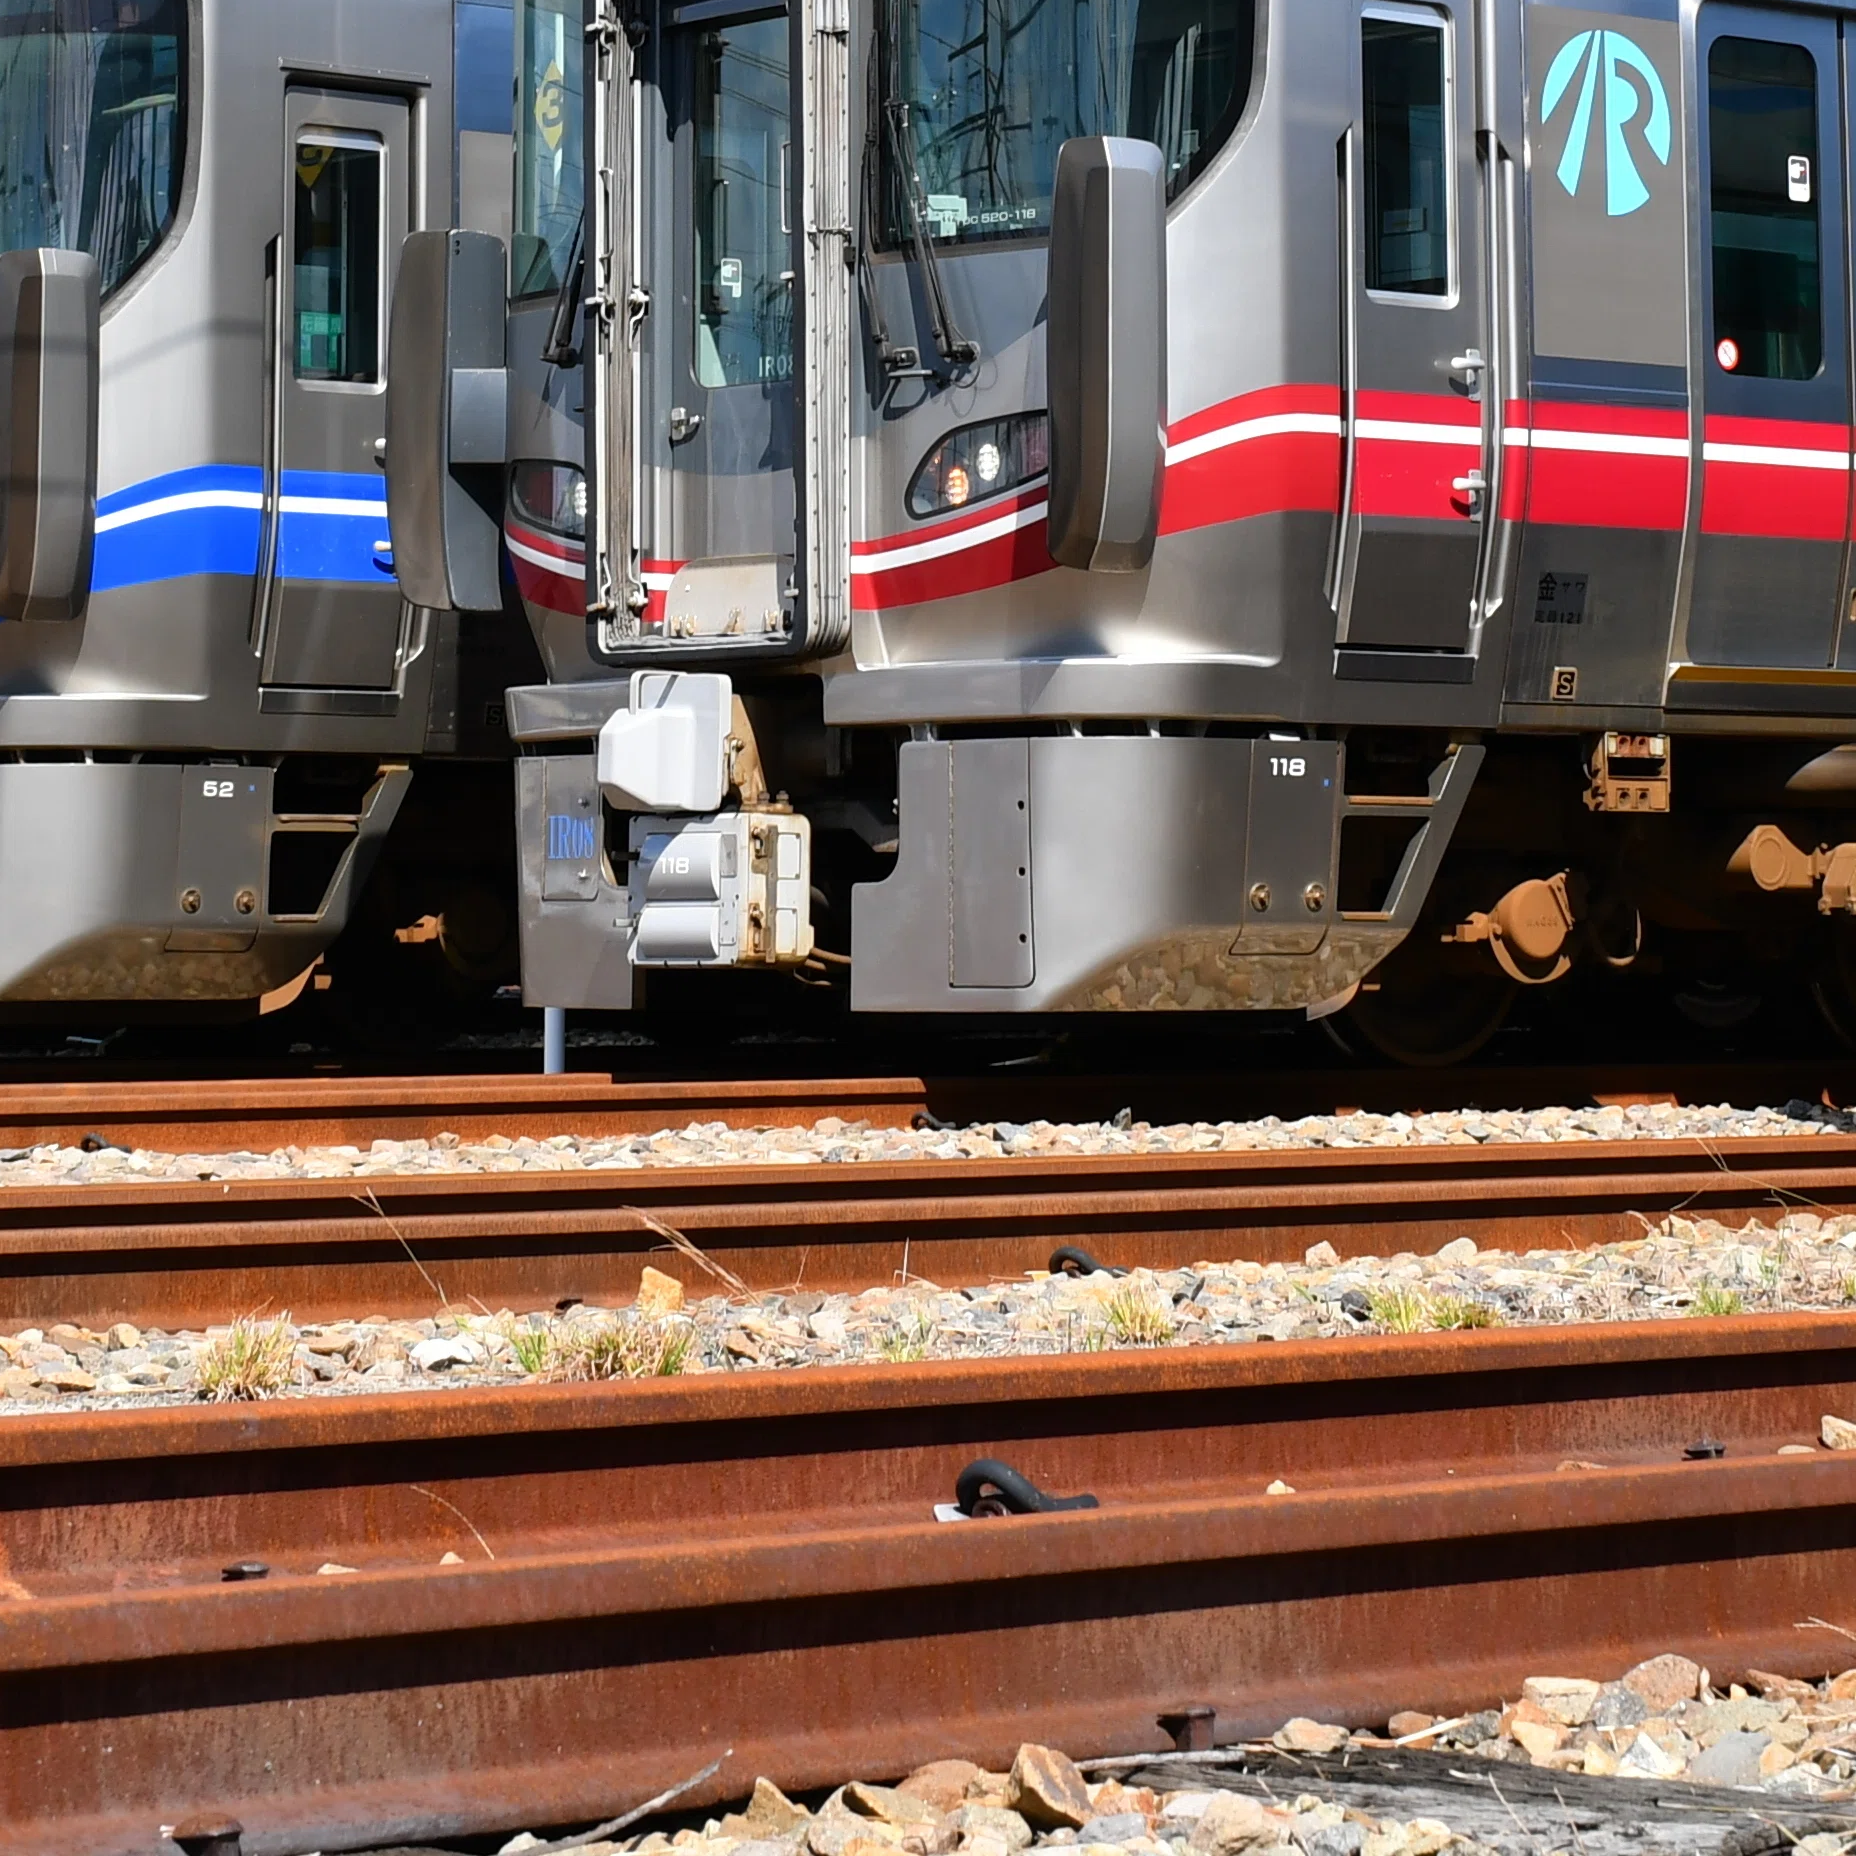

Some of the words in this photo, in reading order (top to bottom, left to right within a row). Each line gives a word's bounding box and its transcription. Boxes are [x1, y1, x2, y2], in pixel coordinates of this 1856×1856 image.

[542, 79, 564, 128] 3
[981, 208, 1036, 223] 520-118
[1270, 757, 1306, 776] 118
[203, 780, 234, 798] 52
[660, 857, 689, 874] 118
